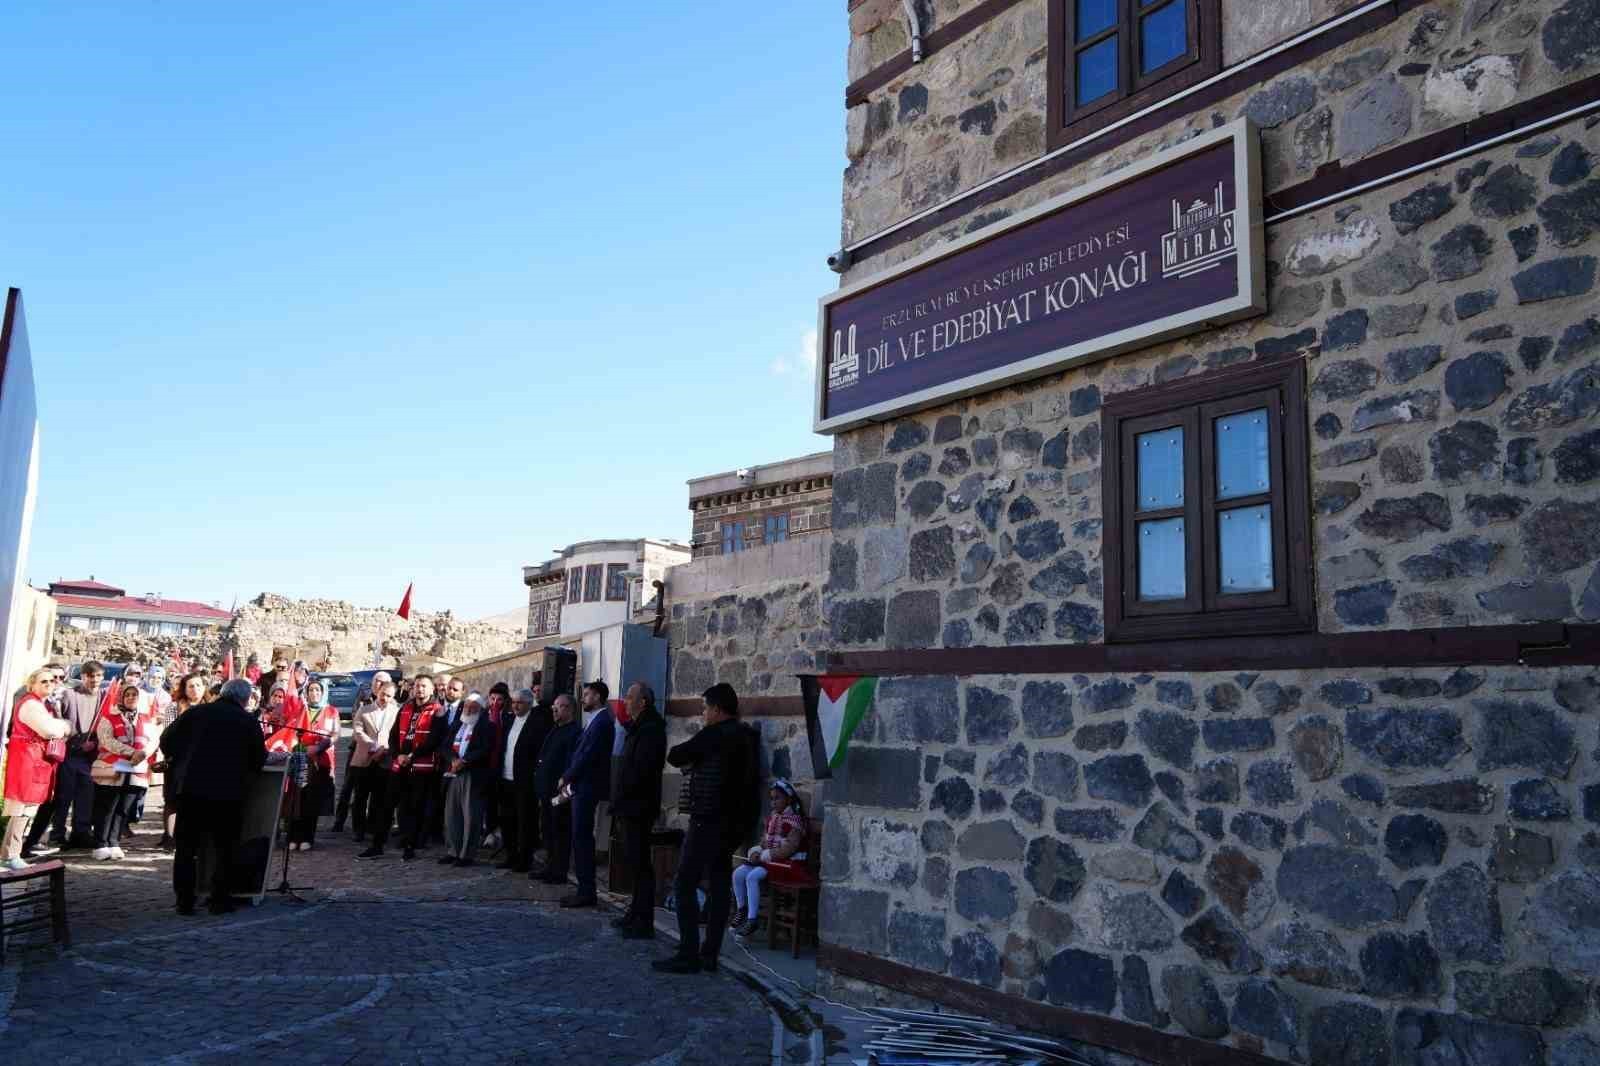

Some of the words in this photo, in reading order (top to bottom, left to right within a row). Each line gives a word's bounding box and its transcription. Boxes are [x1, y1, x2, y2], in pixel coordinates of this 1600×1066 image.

[866, 338, 895, 375] DİL
[898, 328, 926, 361] VE
[932, 289, 1037, 353] EDEBİYAT
[1044, 250, 1148, 315] KONAĞI
